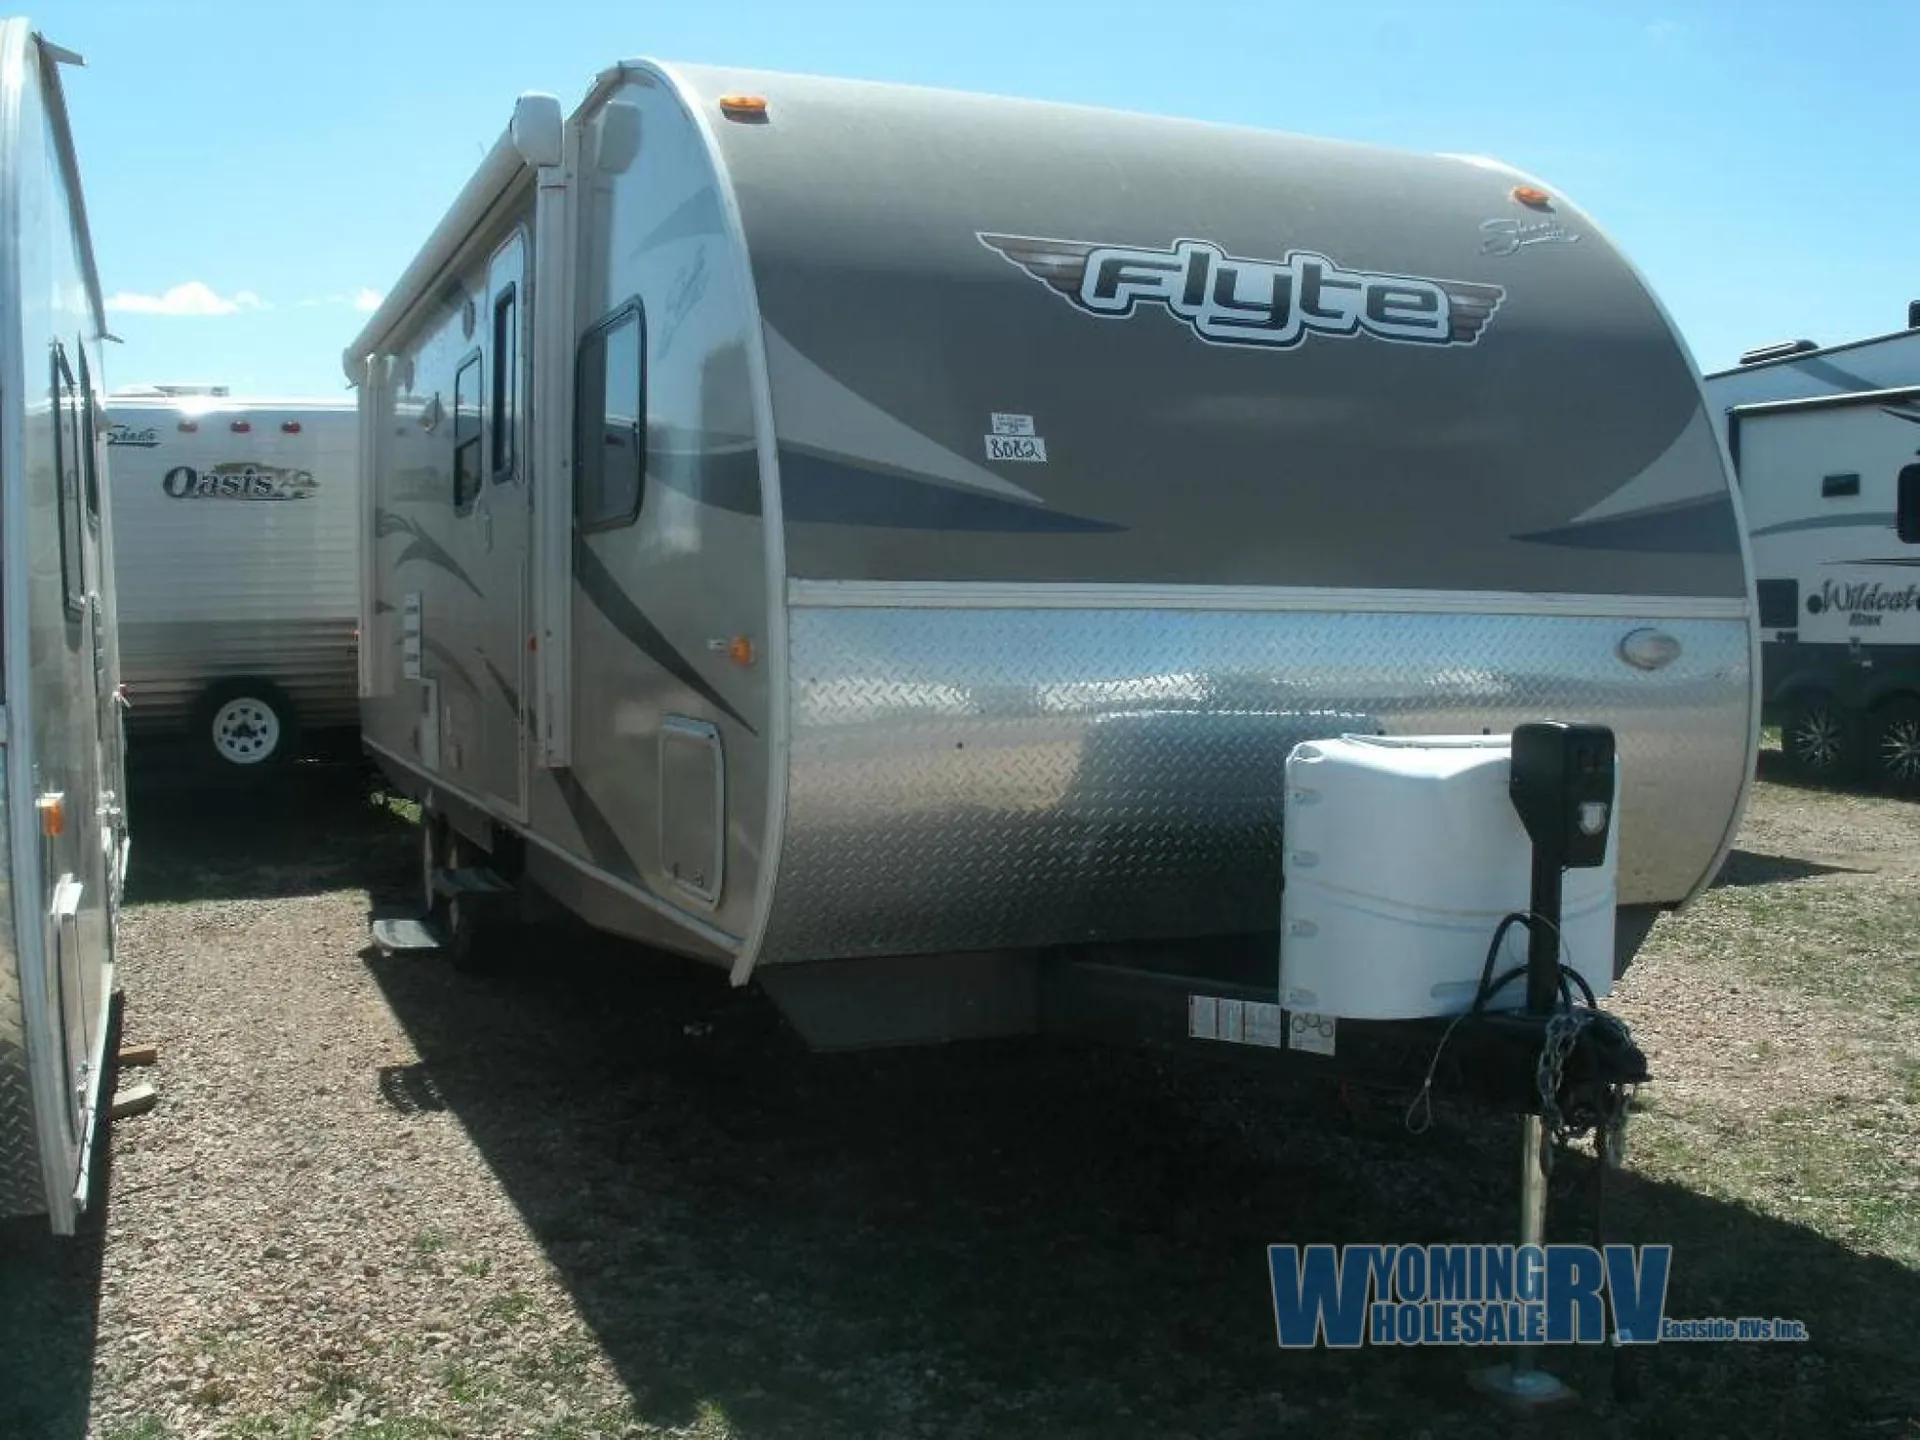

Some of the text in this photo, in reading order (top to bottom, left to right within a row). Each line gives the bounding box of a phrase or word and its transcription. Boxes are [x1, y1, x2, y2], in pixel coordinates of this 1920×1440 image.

[1082, 241, 1449, 342] Flyte
[991, 438, 1041, 458] 8082
[163, 466, 273, 498] Oasis
